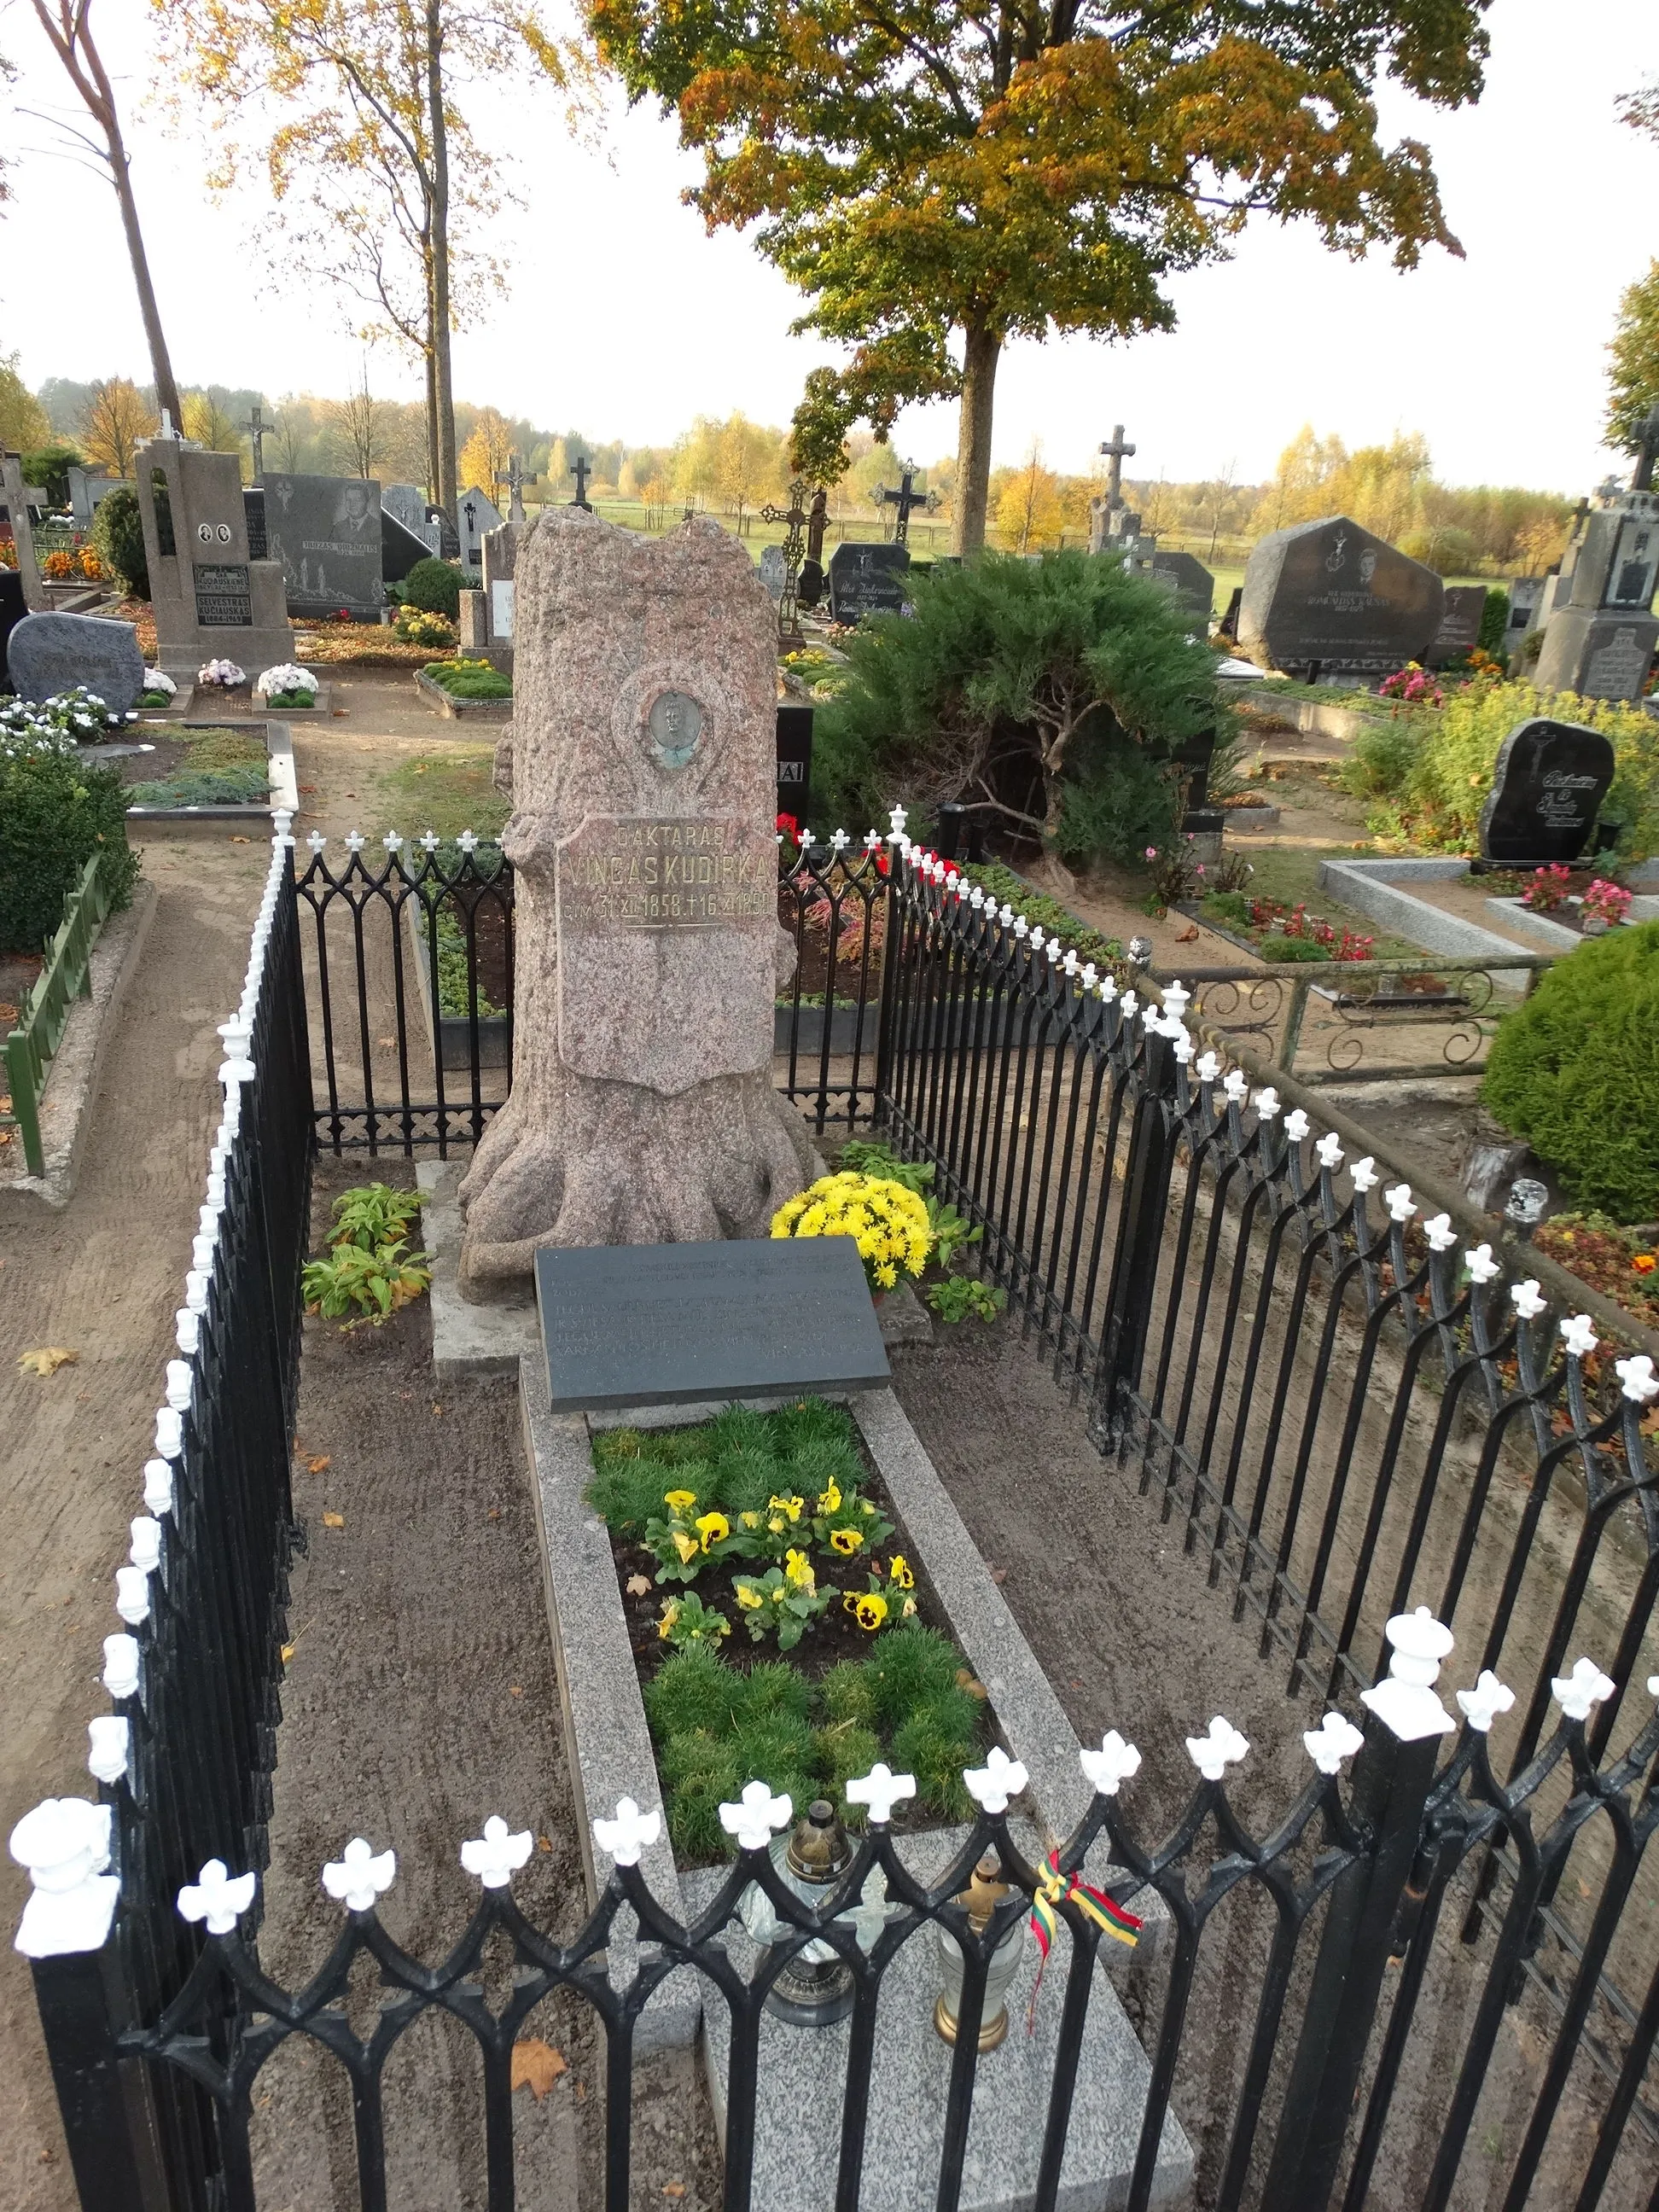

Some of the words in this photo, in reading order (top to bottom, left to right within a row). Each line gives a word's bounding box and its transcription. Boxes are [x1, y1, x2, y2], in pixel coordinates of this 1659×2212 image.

[618, 825, 725, 847] DAKTARAS
[568, 855, 659, 885] VINCAS
[665, 854, 769, 885] KUDIRKA
